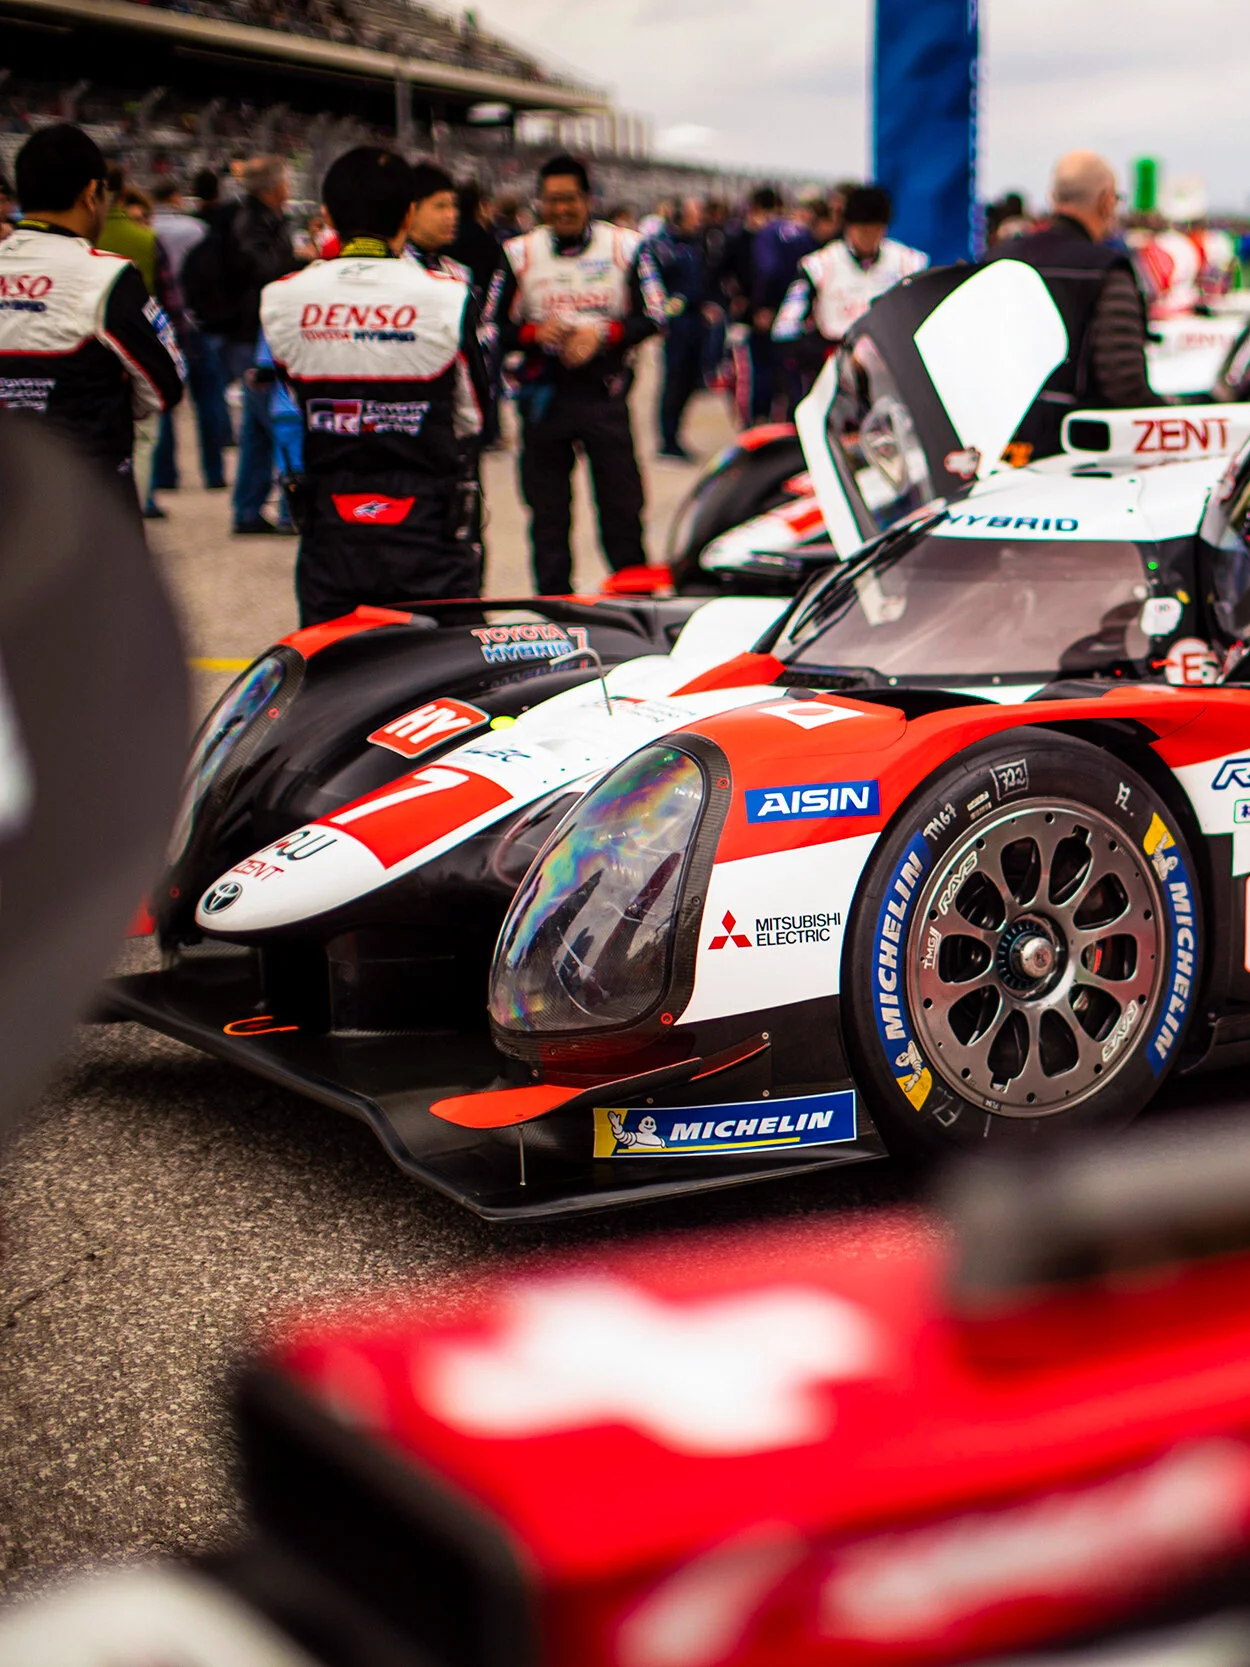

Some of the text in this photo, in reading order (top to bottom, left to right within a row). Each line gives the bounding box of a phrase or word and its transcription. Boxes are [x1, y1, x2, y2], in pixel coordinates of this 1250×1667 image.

[300, 303, 417, 329] DENSO
[1132, 418, 1230, 453] ZENT
[471, 624, 567, 645] TOYOTA
[481, 641, 575, 664] HYBRID
[383, 704, 473, 745] HY
[329, 767, 470, 825] 7
[757, 786, 870, 817] AISIN
[231, 859, 284, 882] ZENT
[938, 851, 979, 916] RAYS
[755, 912, 841, 932] MITSUBISHI
[756, 928, 831, 947] ELECTRIC
[878, 851, 924, 1040] MICHELIN
[1154, 882, 1194, 1060] MICHELIN
[669, 1110, 834, 1141] MICHELIN
